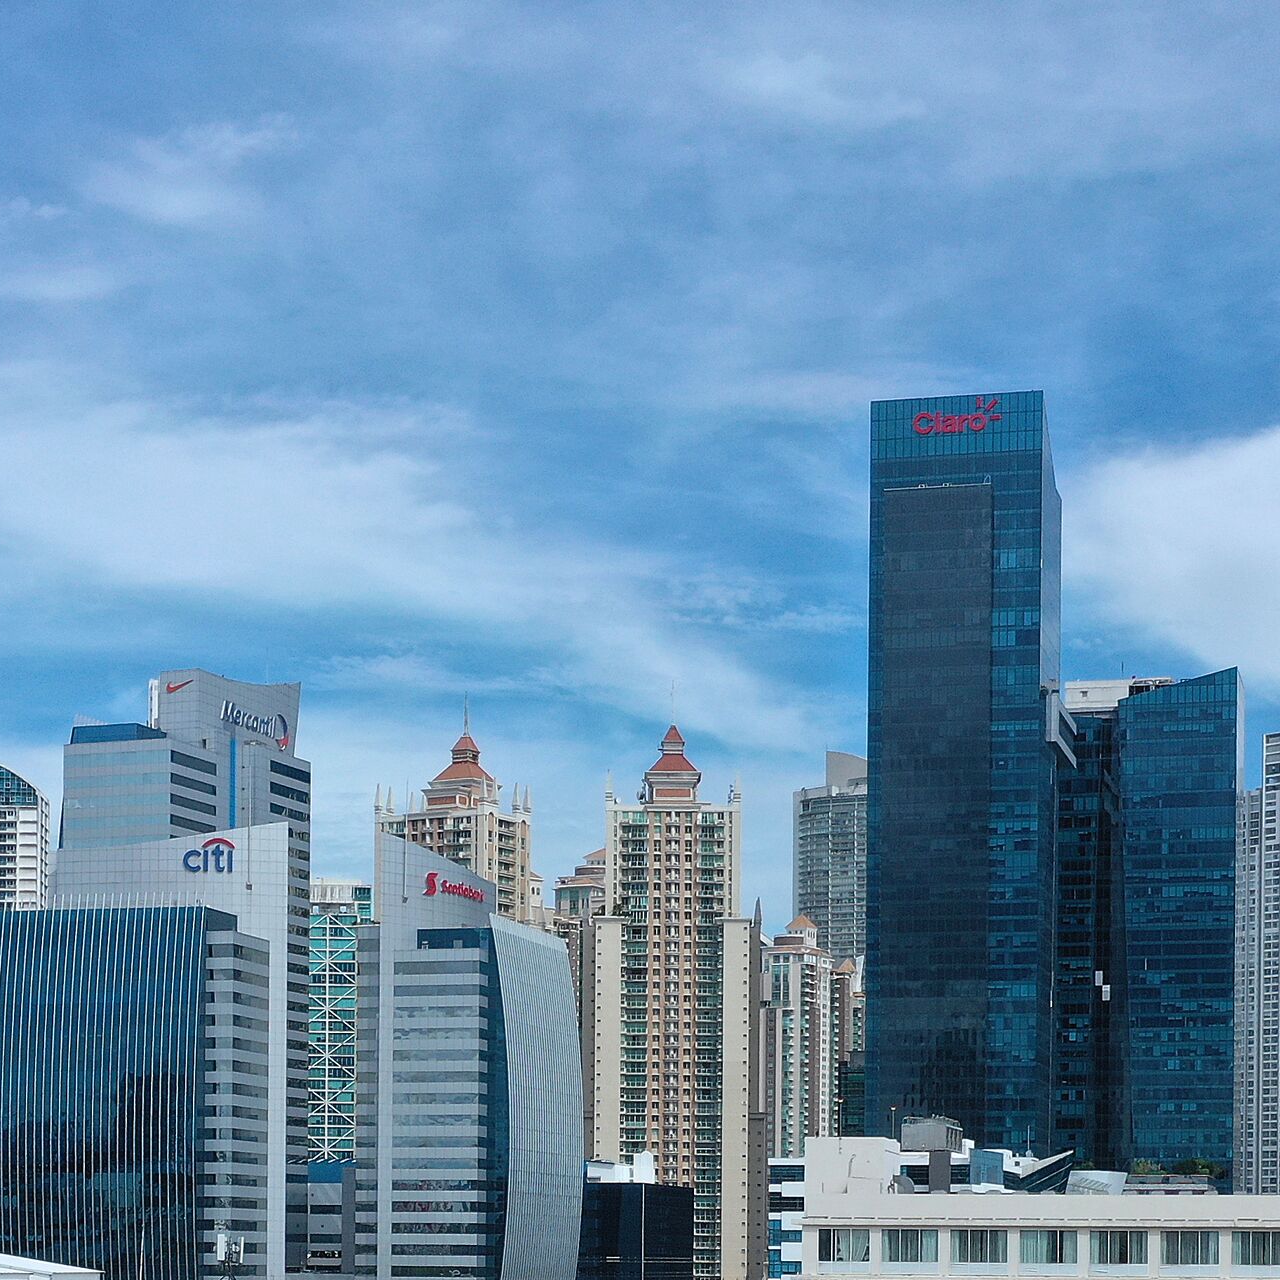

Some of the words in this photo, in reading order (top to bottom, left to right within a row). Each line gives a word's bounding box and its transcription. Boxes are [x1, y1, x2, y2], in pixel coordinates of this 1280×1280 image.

[913, 411, 986, 435] Claro
[220, 700, 276, 739] Mercantil
[183, 841, 235, 873] citi
